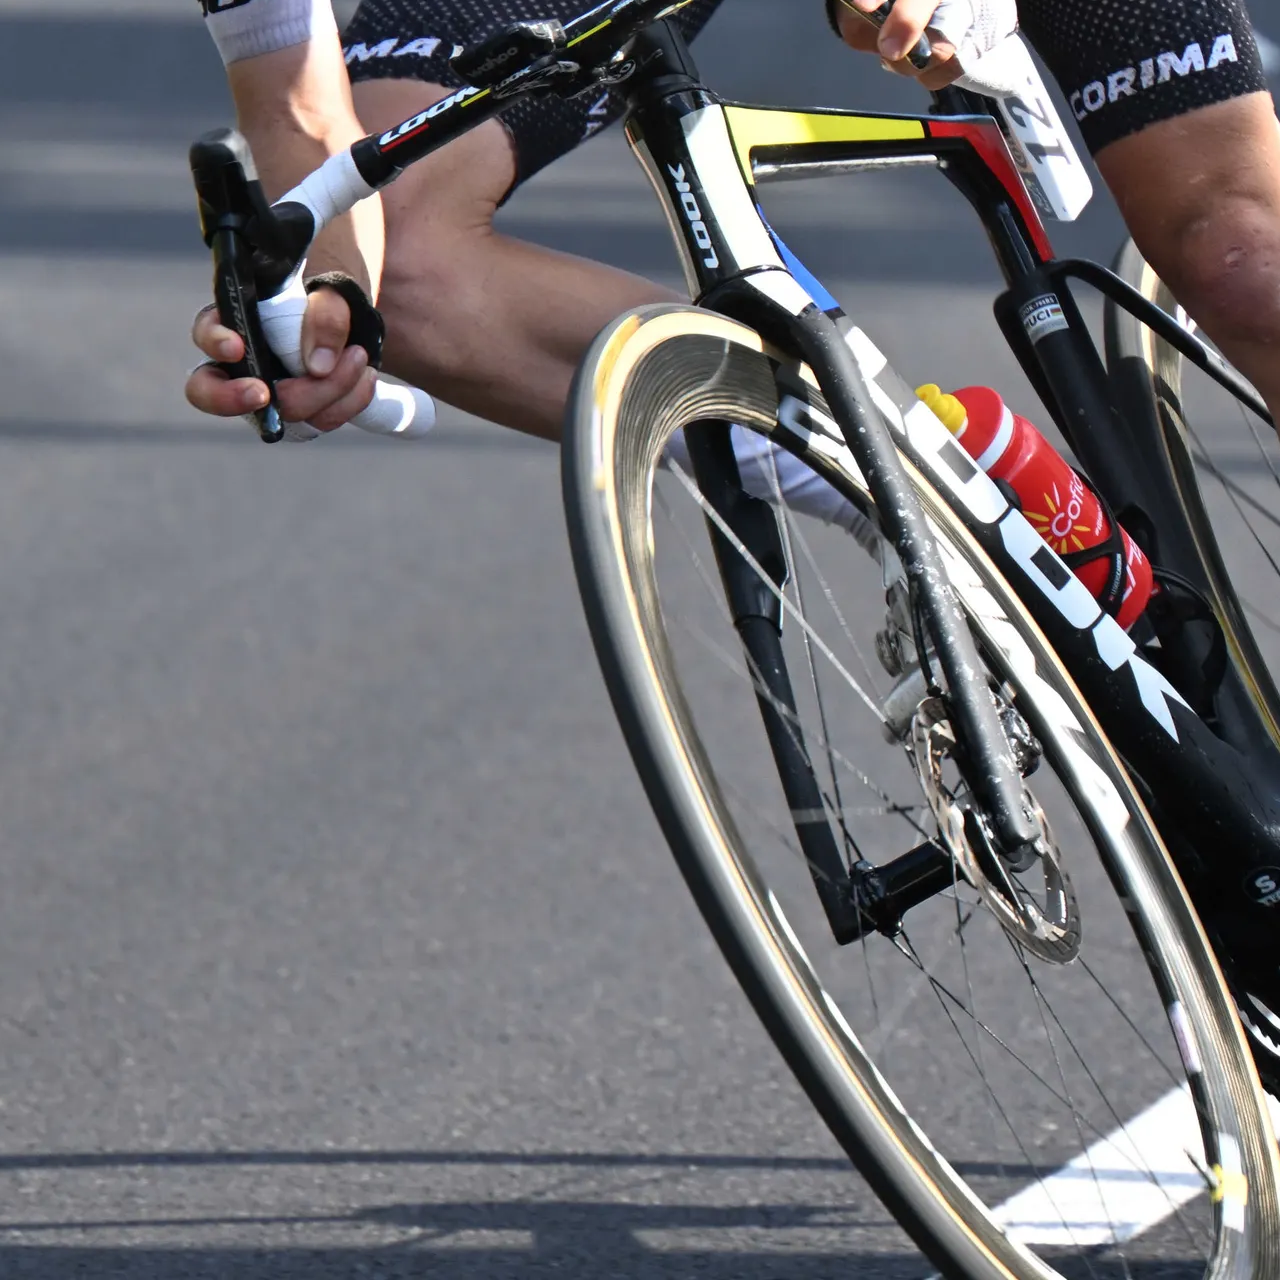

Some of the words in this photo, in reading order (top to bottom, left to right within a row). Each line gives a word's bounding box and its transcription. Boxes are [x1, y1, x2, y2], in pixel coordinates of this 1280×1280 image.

[1070, 33, 1238, 122] CORIMA
[379, 85, 481, 146] LOOK
[667, 162, 719, 269] LOOK
[1028, 308, 1051, 327] UCI
